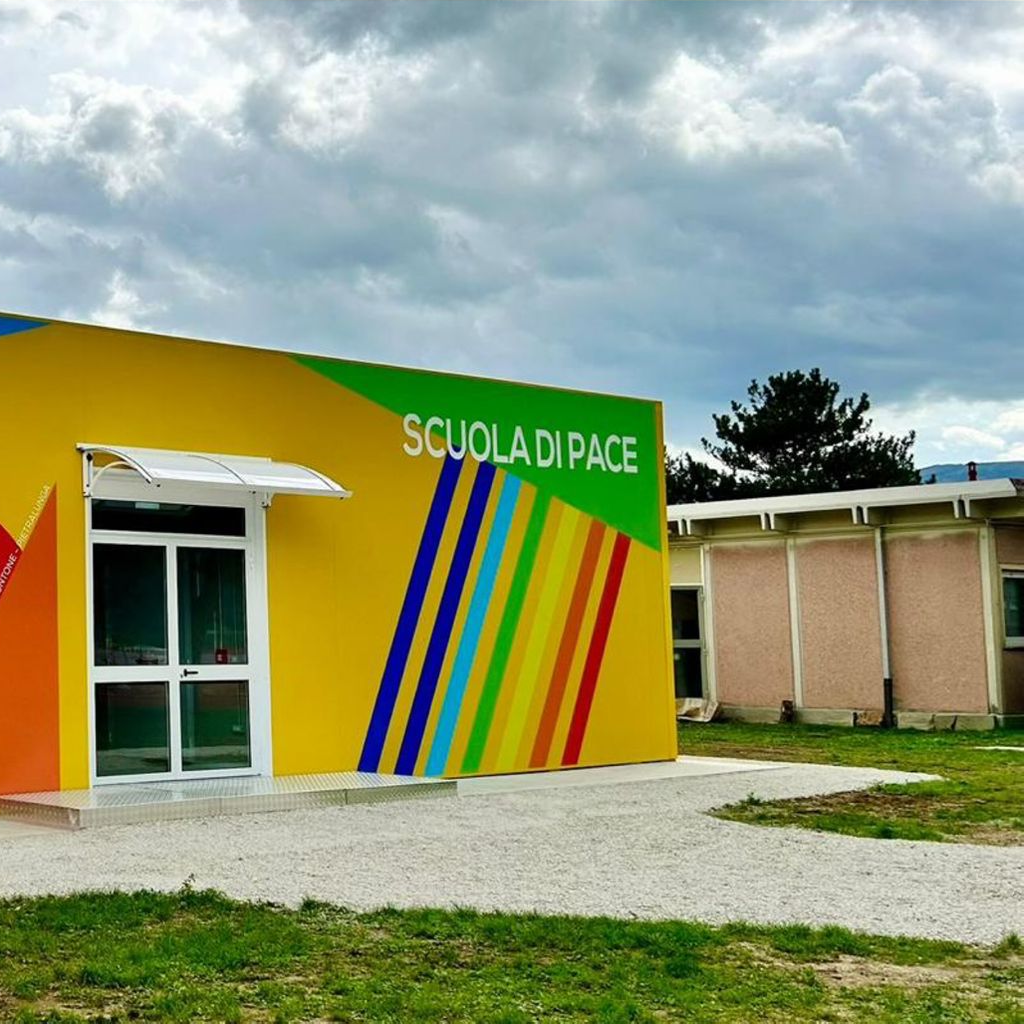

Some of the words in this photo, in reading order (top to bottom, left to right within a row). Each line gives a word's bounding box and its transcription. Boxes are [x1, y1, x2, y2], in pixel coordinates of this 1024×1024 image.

[402, 413, 532, 466] SCUOLA
[535, 428, 562, 469] DI
[568, 431, 639, 474] PACE
[16, 484, 51, 547] PIETRALUNGA
